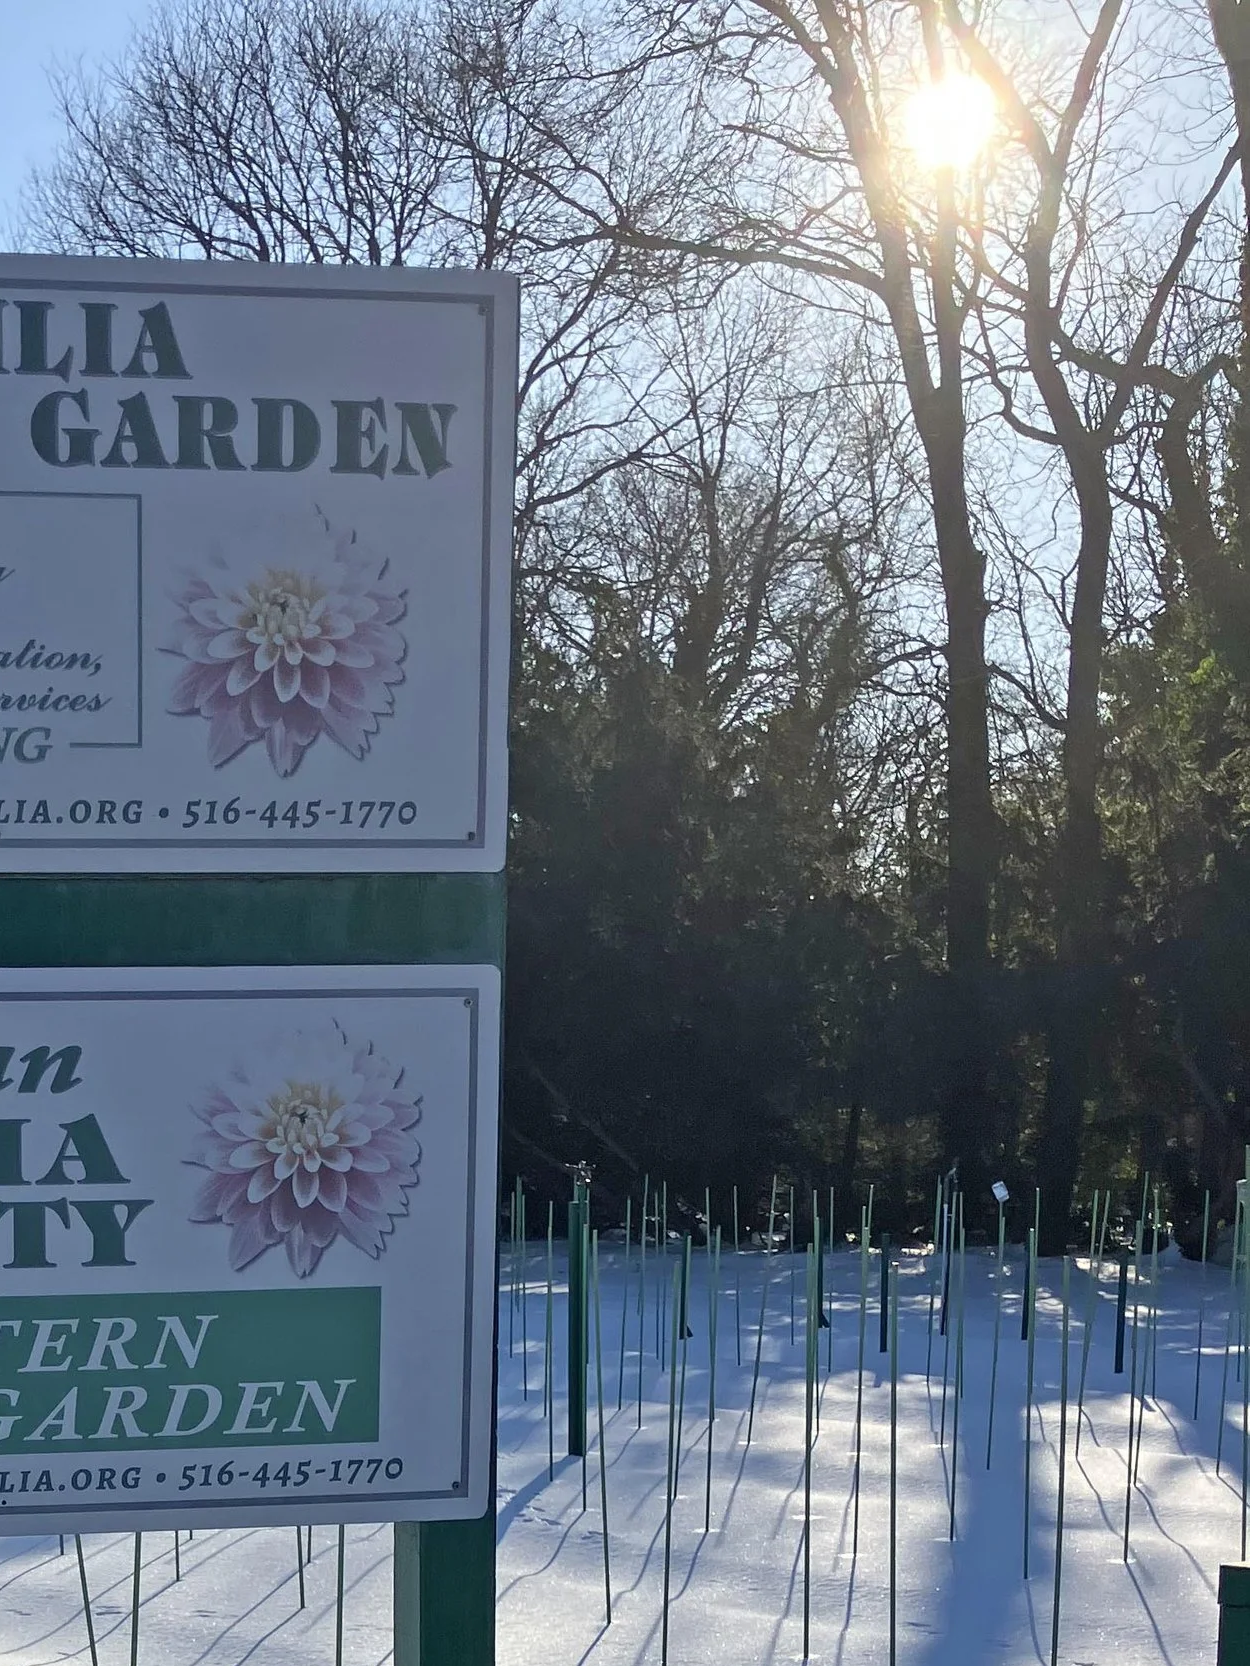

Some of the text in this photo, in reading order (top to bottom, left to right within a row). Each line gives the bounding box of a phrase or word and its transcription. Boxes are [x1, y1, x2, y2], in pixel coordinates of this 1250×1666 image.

[31, 388, 456, 480] GARDEN
[182, 797, 417, 829] 516-445-1770
[178, 1457, 405, 1491] 516-445-1770
